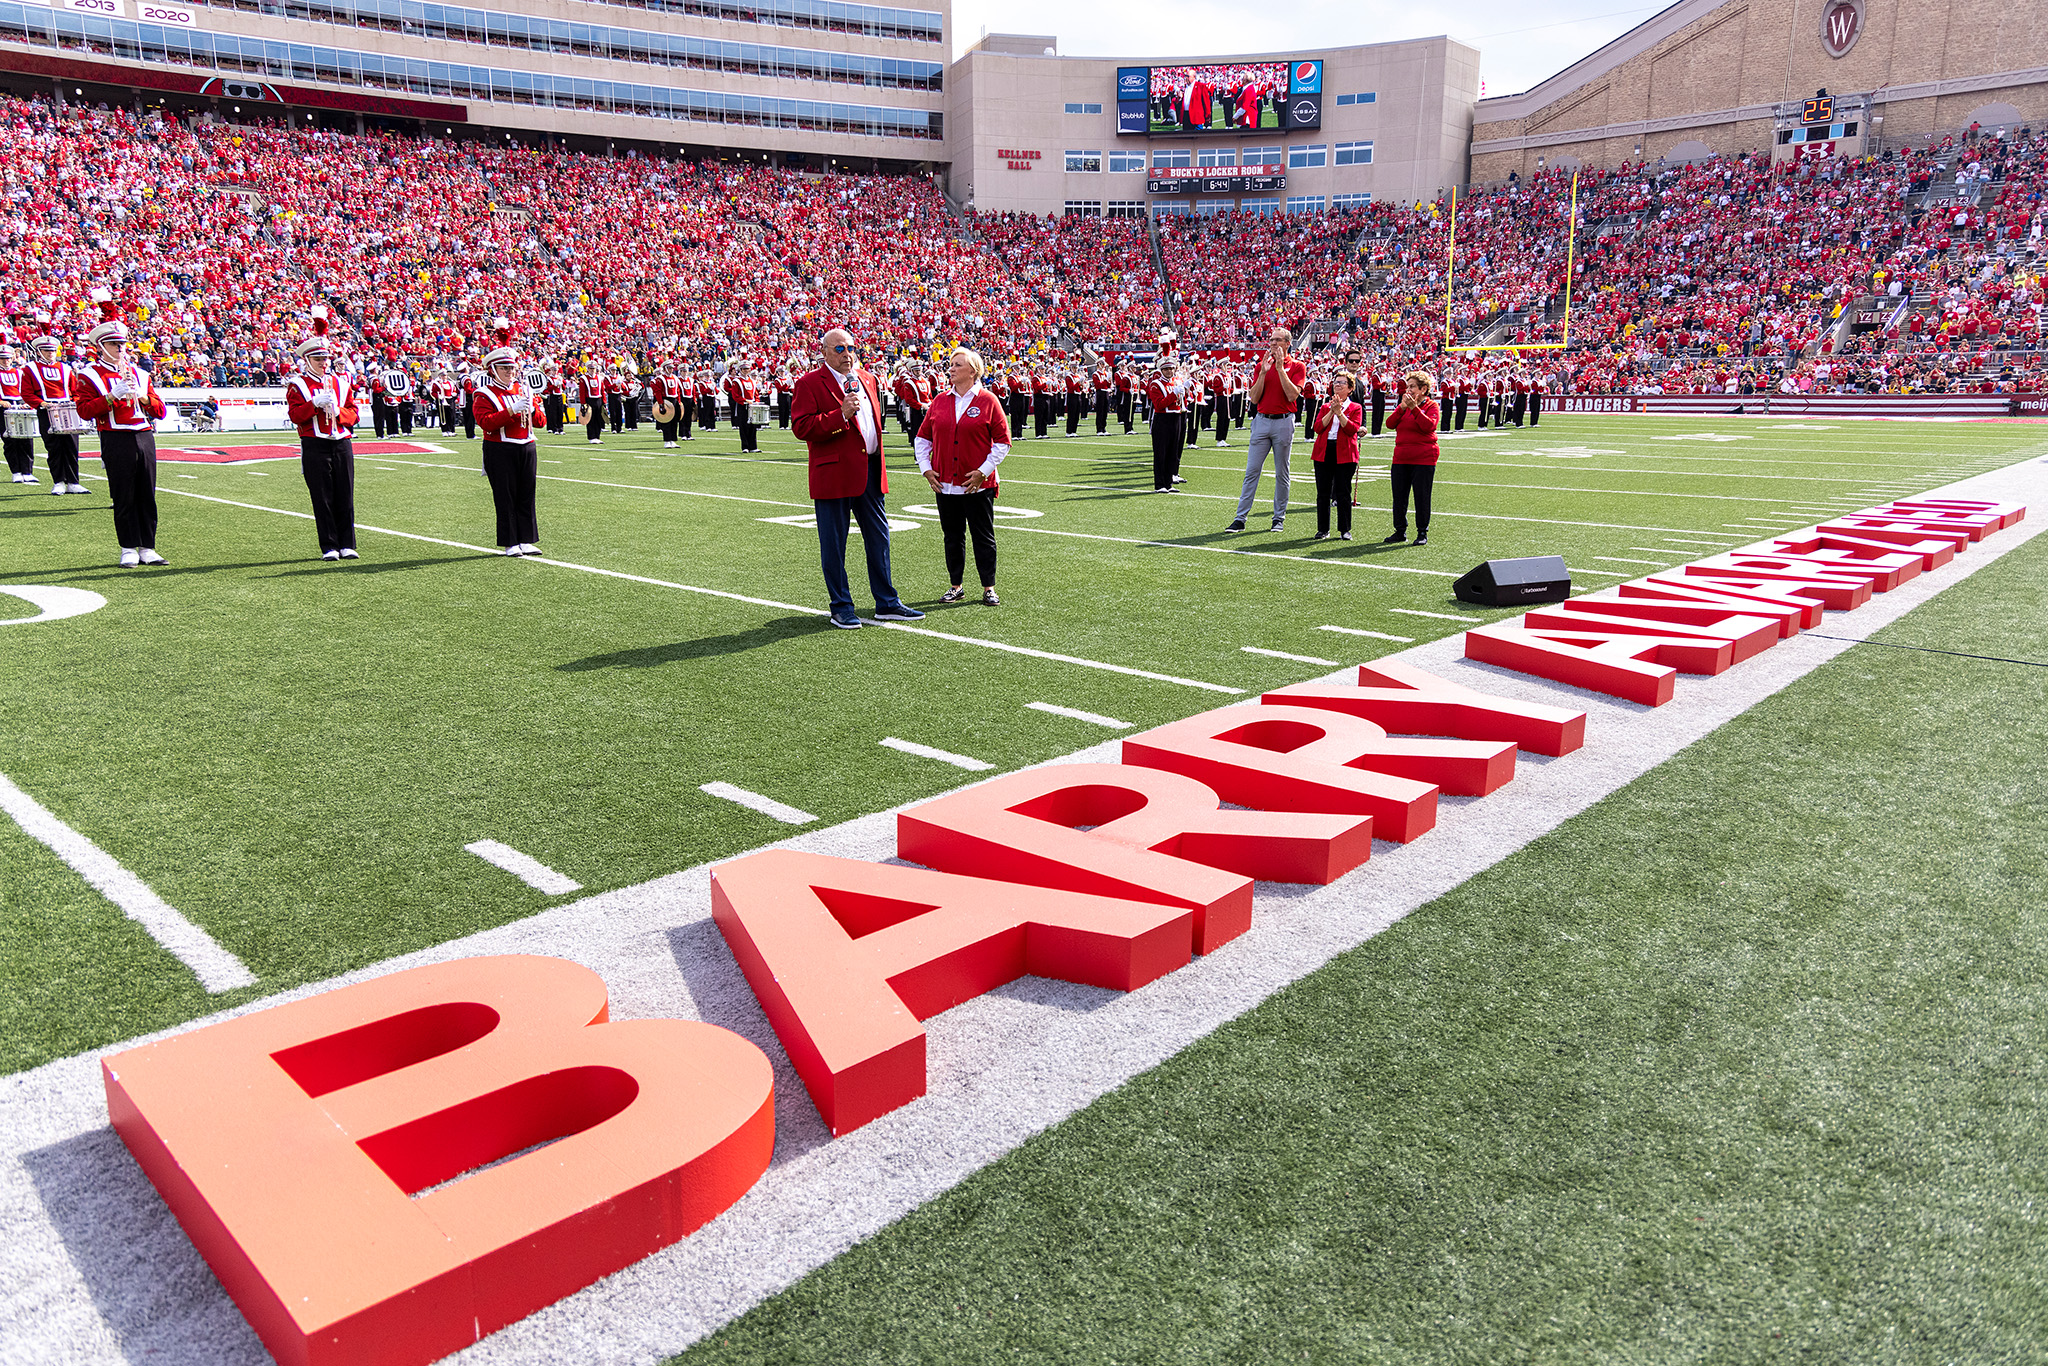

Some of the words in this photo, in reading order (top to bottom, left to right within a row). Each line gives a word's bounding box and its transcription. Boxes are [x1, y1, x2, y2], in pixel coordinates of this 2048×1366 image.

[74, 0, 116, 12] 2013
[144, 7, 190, 23] 2020
[1829, 11, 1856, 46] W
[1297, 85, 1315, 93] pepsi
[1803, 99, 1832, 121] 25
[1120, 112, 1145, 120] StubHub
[998, 149, 1042, 160] KELLNER
[1007, 161, 1032, 171] HALL
[1170, 167, 1204, 177] BUCKY'S
[1206, 166, 1239, 177] LOCKER
[1241, 165, 1264, 176] ROOM
[1150, 182, 1159, 191] 10
[1209, 180, 1228, 190] 6:44
[1276, 178, 1286, 188] 13
[1564, 397, 1632, 412] BADGERS
[2020, 398, 2048, 412] meij
[1524, 586, 1548, 594] Turbosound
[101, 655, 1588, 1366] BARRY
[1465, 529, 1957, 707] ALVAREZ
